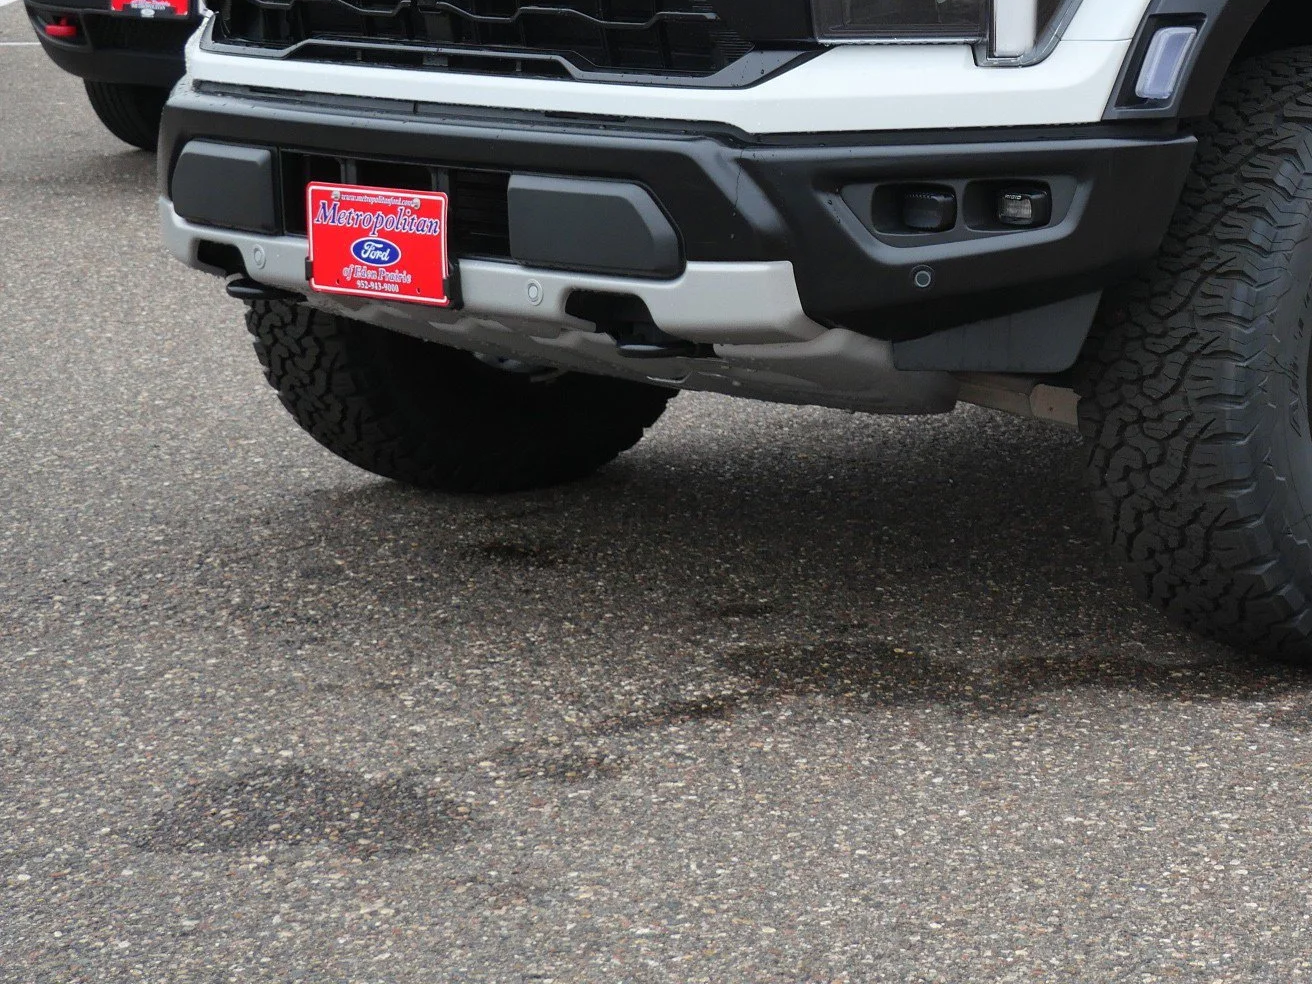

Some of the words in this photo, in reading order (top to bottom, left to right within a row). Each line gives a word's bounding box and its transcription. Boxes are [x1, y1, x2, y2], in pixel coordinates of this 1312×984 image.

[314, 200, 441, 236] Metropolitan
[360, 241, 391, 261] Ford
[342, 264, 354, 281] of
[353, 265, 377, 279] Eden
[377, 268, 411, 283] Prairie
